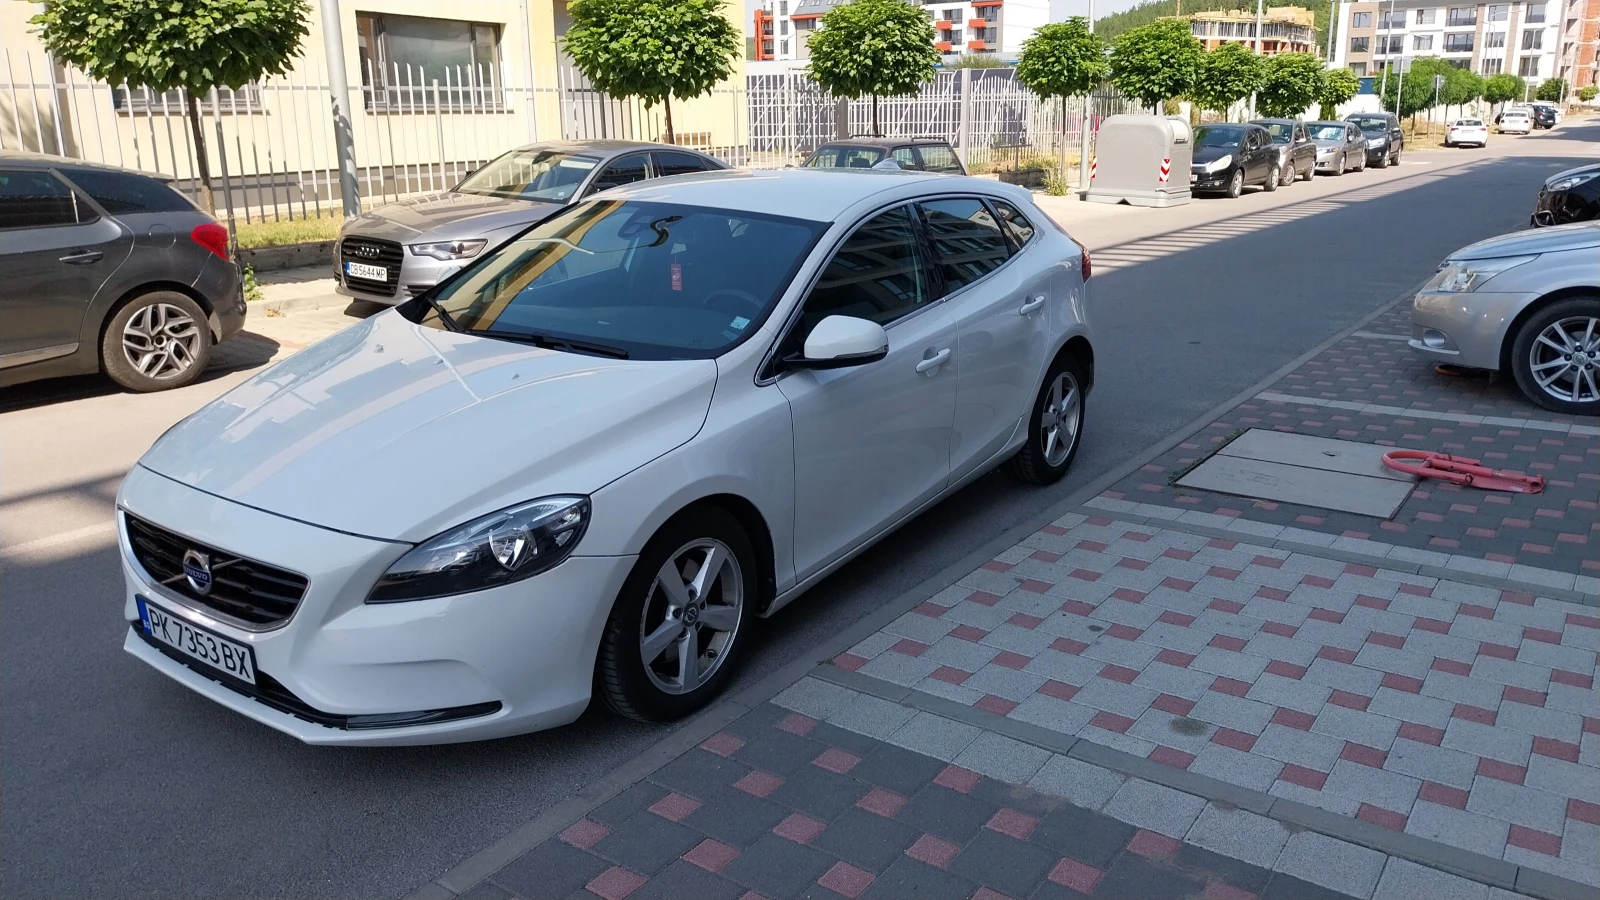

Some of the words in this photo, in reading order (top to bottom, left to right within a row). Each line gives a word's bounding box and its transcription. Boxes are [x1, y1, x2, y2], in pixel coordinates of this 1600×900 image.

[184, 566, 208, 581] VOLVO
[149, 608, 173, 643] PK
[173, 621, 220, 664] 7353
[221, 643, 251, 679] BX
